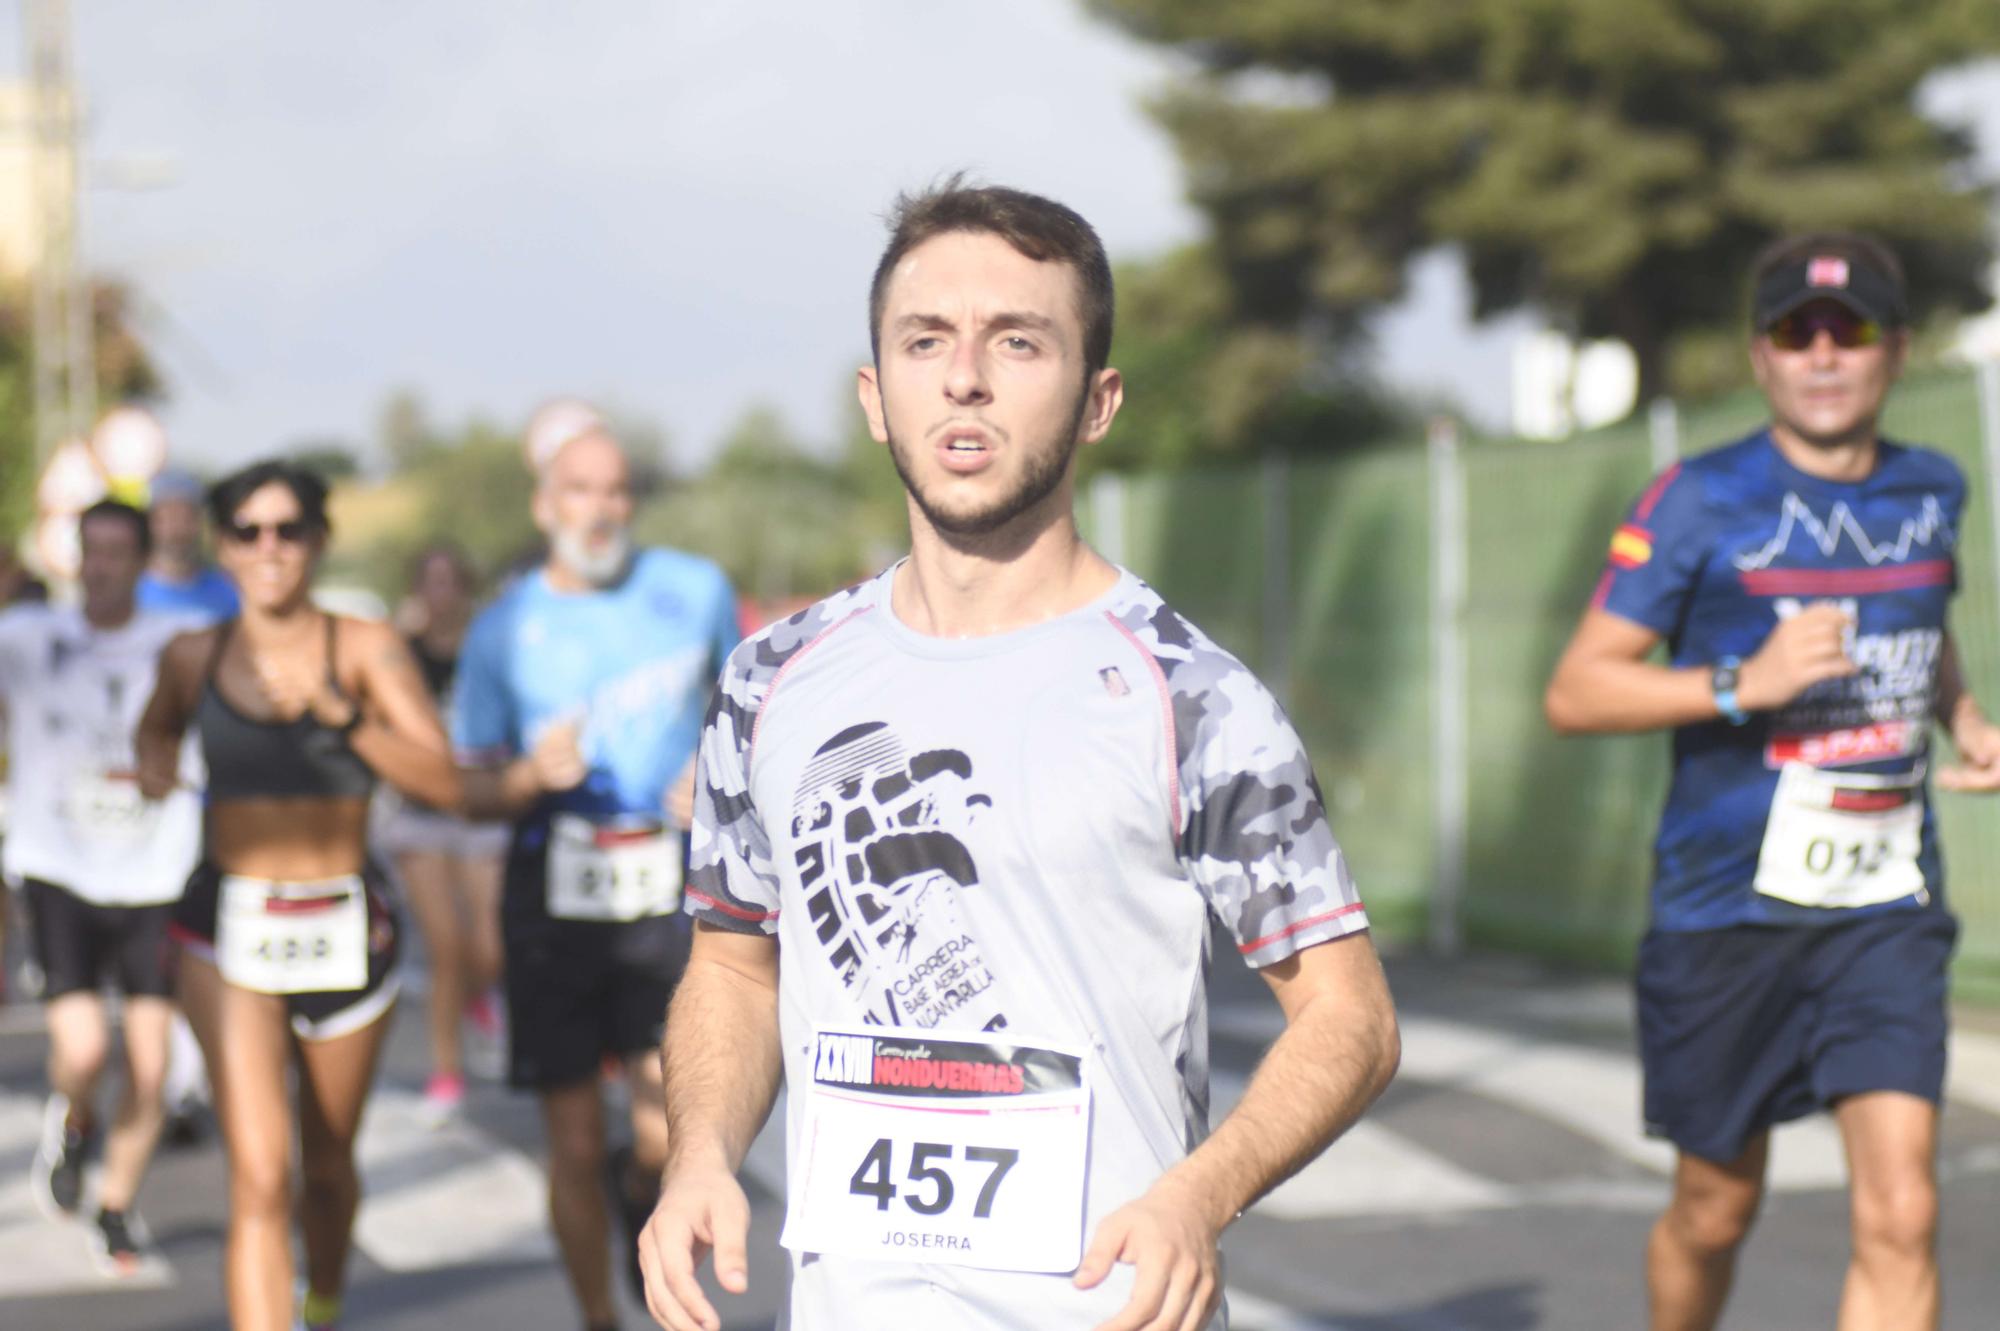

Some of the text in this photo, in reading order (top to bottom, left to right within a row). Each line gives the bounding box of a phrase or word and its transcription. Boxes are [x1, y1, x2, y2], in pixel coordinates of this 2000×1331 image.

[894, 934, 975, 996] CARRERA
[902, 986, 931, 1015] BASE
[934, 959, 969, 992] AEREA
[873, 1055, 1025, 1094] NONDUERMAS
[849, 1138, 1019, 1219] 457
[881, 1231, 972, 1251] JOSERRA
